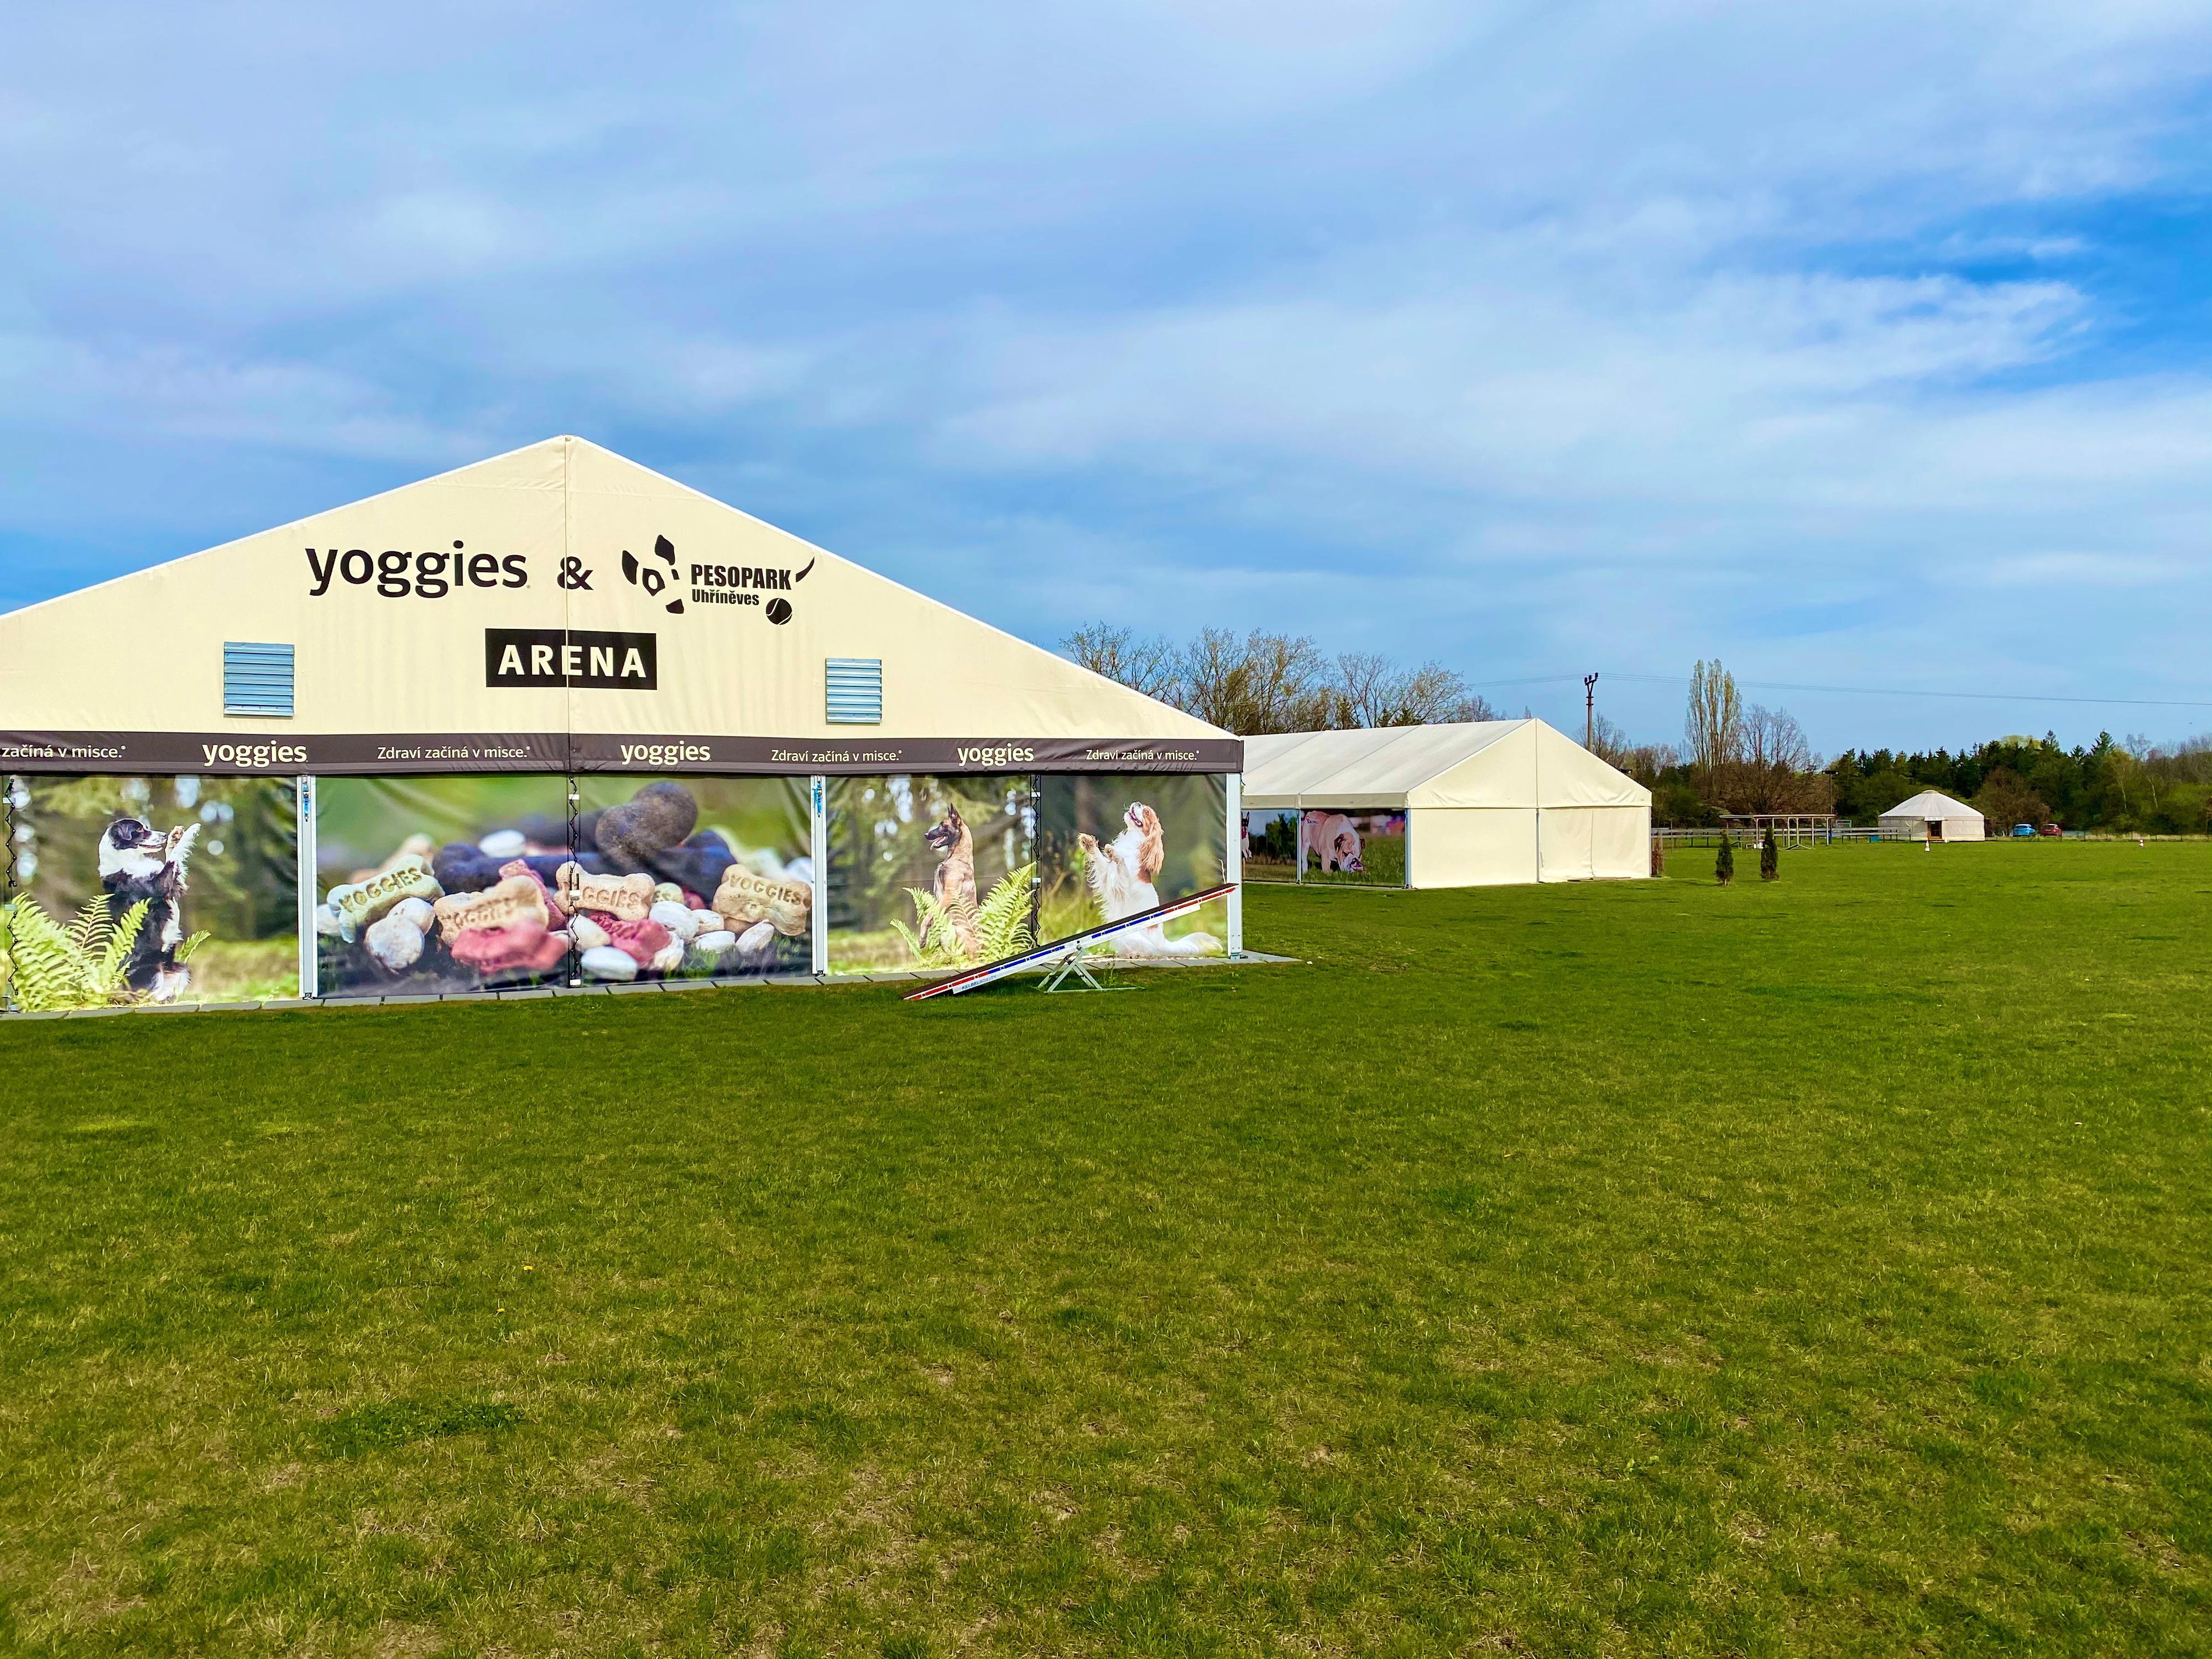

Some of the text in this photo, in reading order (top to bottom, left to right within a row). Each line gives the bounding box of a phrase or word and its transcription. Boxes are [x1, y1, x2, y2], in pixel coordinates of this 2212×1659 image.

[305, 540, 594, 598] yoggies &
[691, 564, 792, 590] PESOPARK
[692, 588, 759, 606] Uhříněves
[498, 644, 646, 678] ARENA
[1, 744, 122, 758] začíná v misce.
[202, 740, 307, 768] yoggies
[377, 745, 528, 759] Zdraví začíná v misce.
[620, 740, 711, 765] yoggies
[771, 749, 900, 762] Zdraví začíná v misce.
[957, 743, 1034, 766] yoggies
[1086, 749, 1118, 760] Zdraví
[1121, 750, 1154, 760] začíná
[1165, 750, 1197, 760] misce.
[338, 867, 422, 912] YOGGIES
[729, 874, 801, 905] YOGGIES
